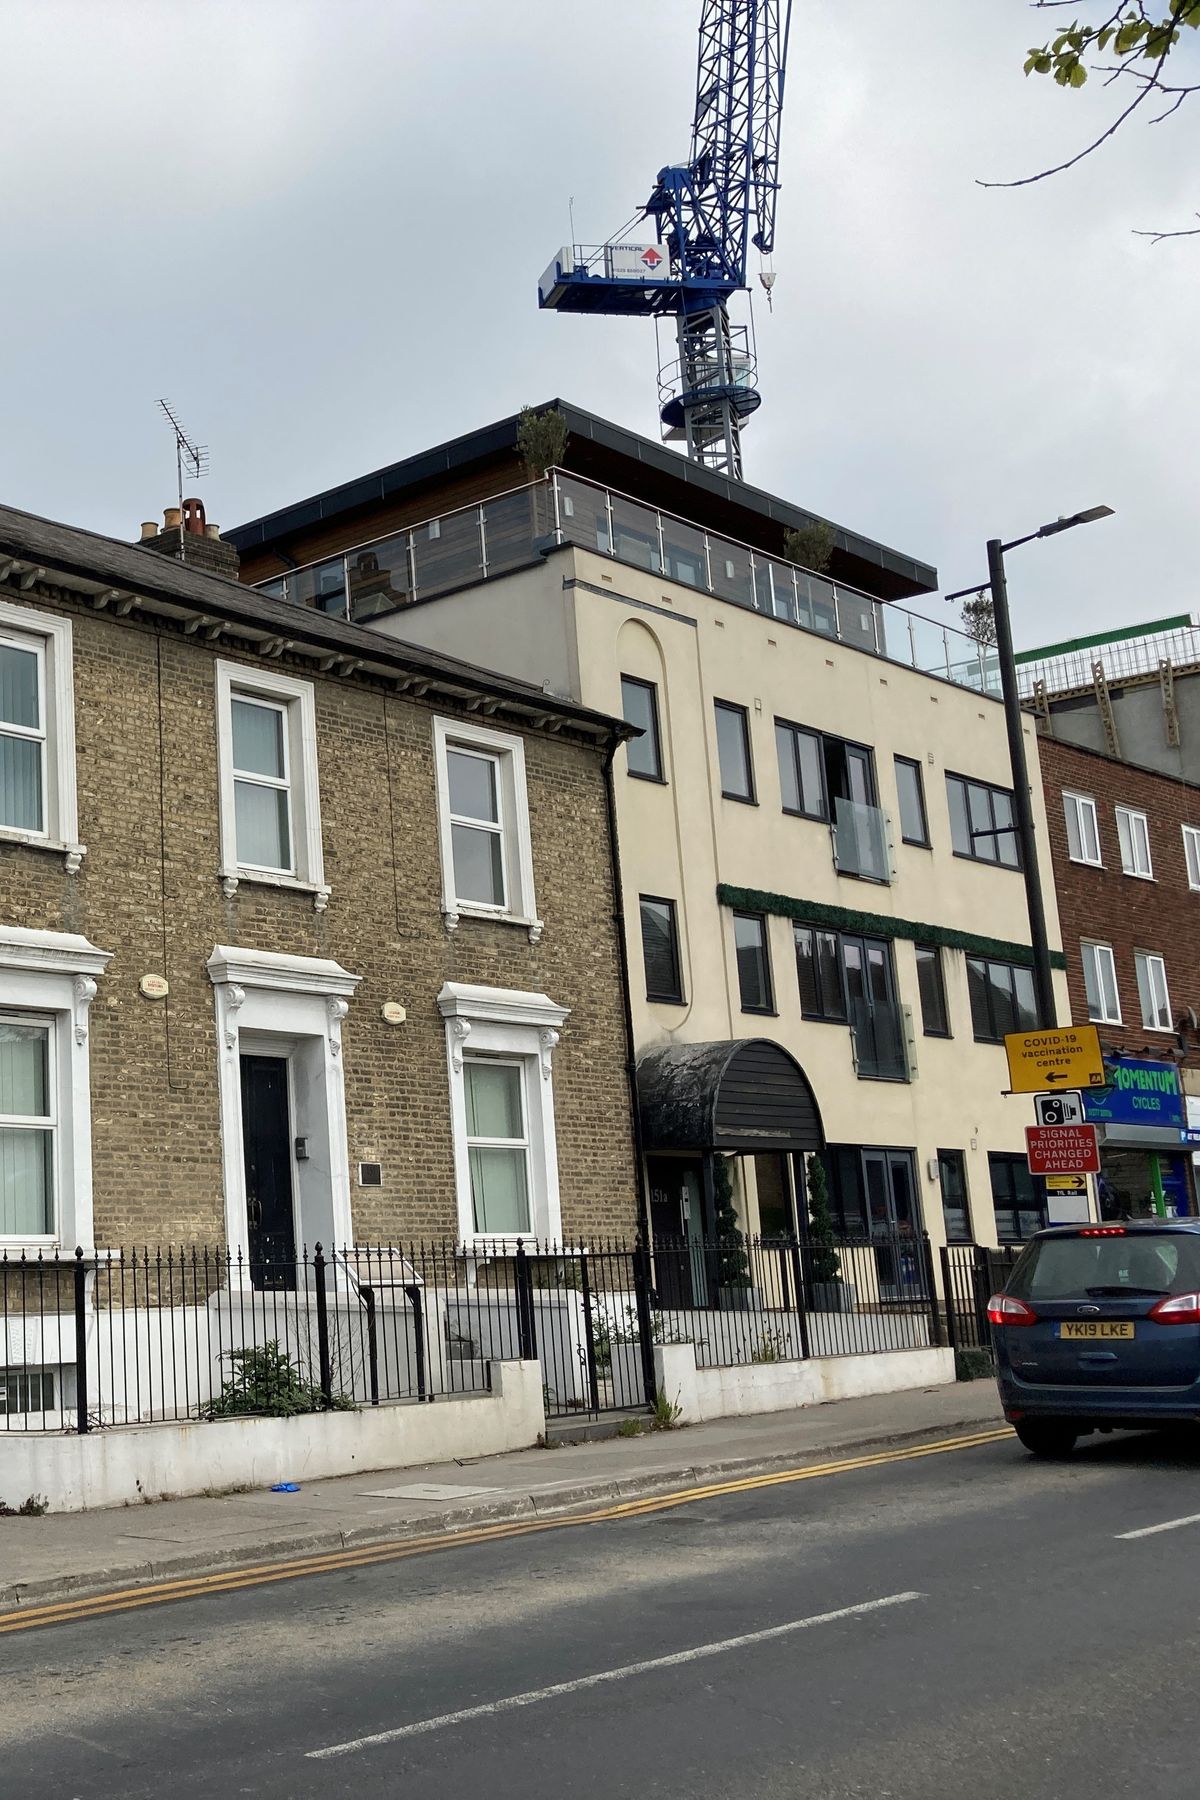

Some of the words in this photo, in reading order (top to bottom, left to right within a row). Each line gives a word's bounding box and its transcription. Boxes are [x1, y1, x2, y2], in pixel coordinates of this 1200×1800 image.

[1024, 1034, 1077, 1047] COVID-19
[1022, 1046, 1083, 1058] vaccination
[1036, 1057, 1071, 1067] centre
[1132, 1096, 1161, 1110] CYCLES
[1040, 1129, 1082, 1139] SIGNAL
[1030, 1138, 1093, 1149] PRIORITIES
[1034, 1149, 1092, 1159] CHANGED
[1045, 1159, 1084, 1169] AHEAD
[1066, 1323, 1097, 1337] YK19
[1100, 1323, 1129, 1337] LKE
